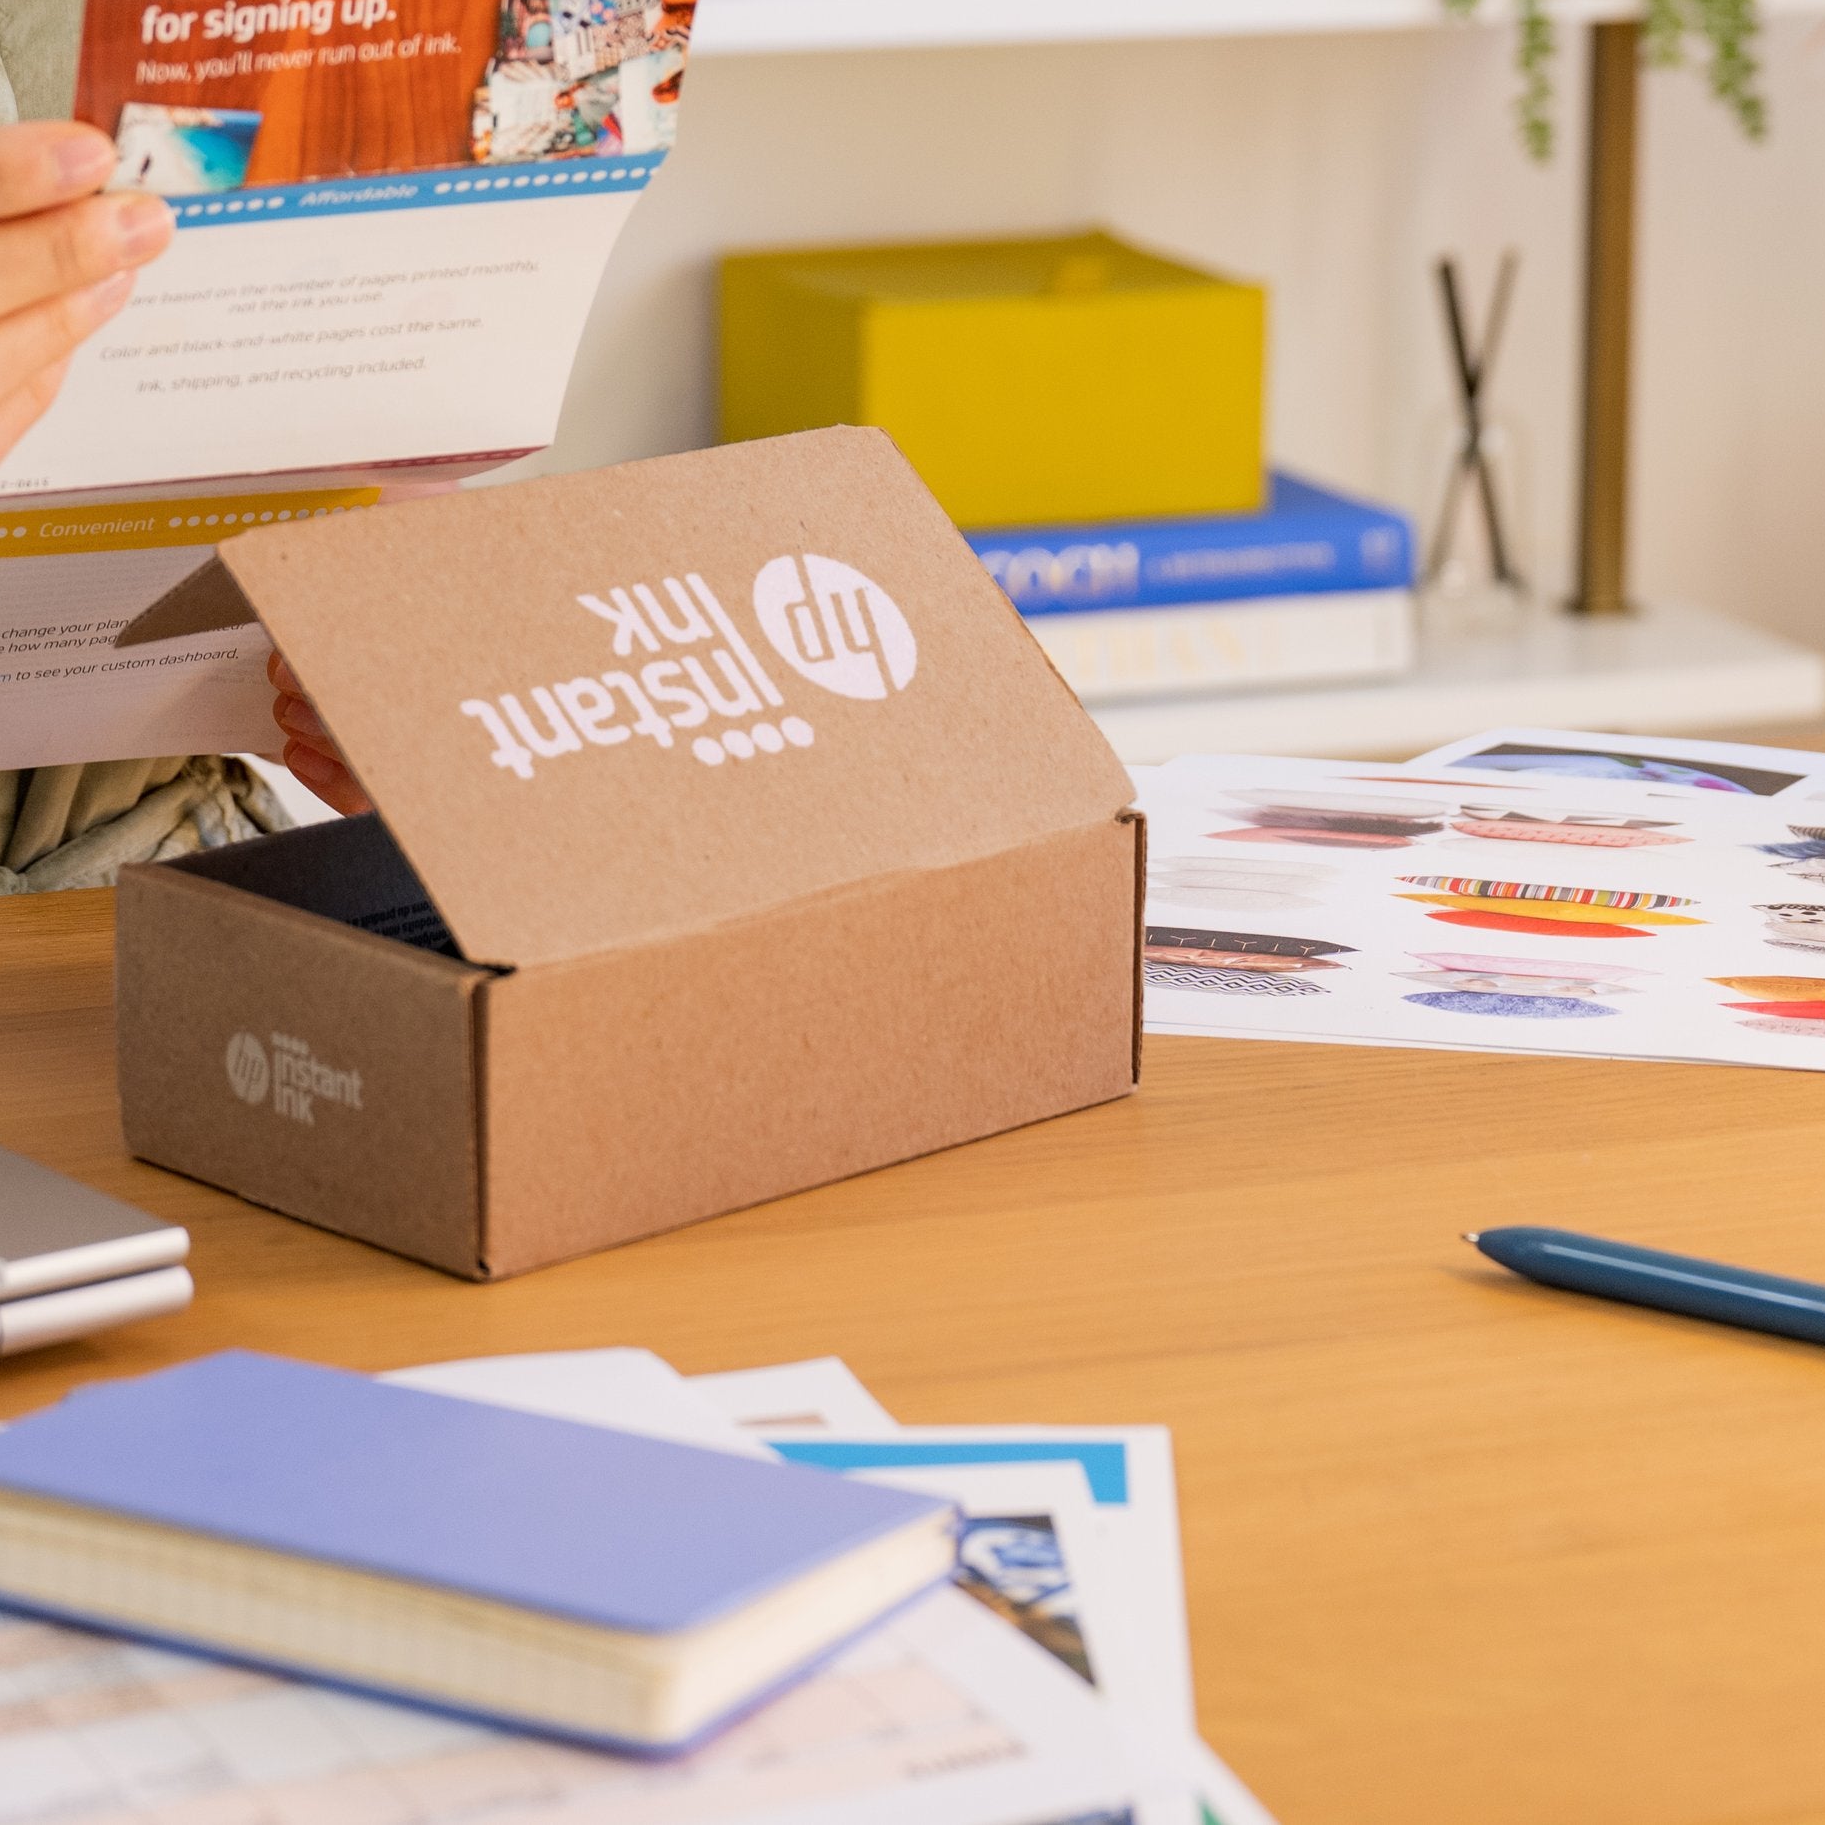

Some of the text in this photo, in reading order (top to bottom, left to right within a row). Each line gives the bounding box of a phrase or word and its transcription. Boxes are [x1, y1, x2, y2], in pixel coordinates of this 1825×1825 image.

[140, 5, 198, 45] for
[135, 31, 461, 85] Now, you'll never run out of ink.
[298, 183, 419, 208] Affordable
[160, 289, 212, 306] based
[215, 287, 237, 301] on
[240, 282, 268, 296] the
[270, 277, 335, 294] number
[339, 275, 357, 289] of
[359, 272, 408, 289] pages
[411, 266, 470, 284] printed
[99, 344, 143, 362] Color
[148, 340, 179, 357] and
[317, 325, 367, 345] pages
[370, 321, 404, 337] cost
[407, 318, 435, 334] the
[247, 368, 280, 385] and
[282, 360, 354, 382] recycling
[39, 516, 156, 538] Convenient
[1, 625, 56, 640] change
[59, 622, 94, 636] your
[8, 640, 41, 654] how
[43, 635, 87, 651] many
[88, 633, 119, 647] pag
[752, 552, 918, 701] hp
[15, 670, 32, 682] to
[34, 667, 61, 680] see
[64, 663, 100, 677] your
[101, 657, 156, 673] custom
[158, 647, 240, 667] dashboard.
